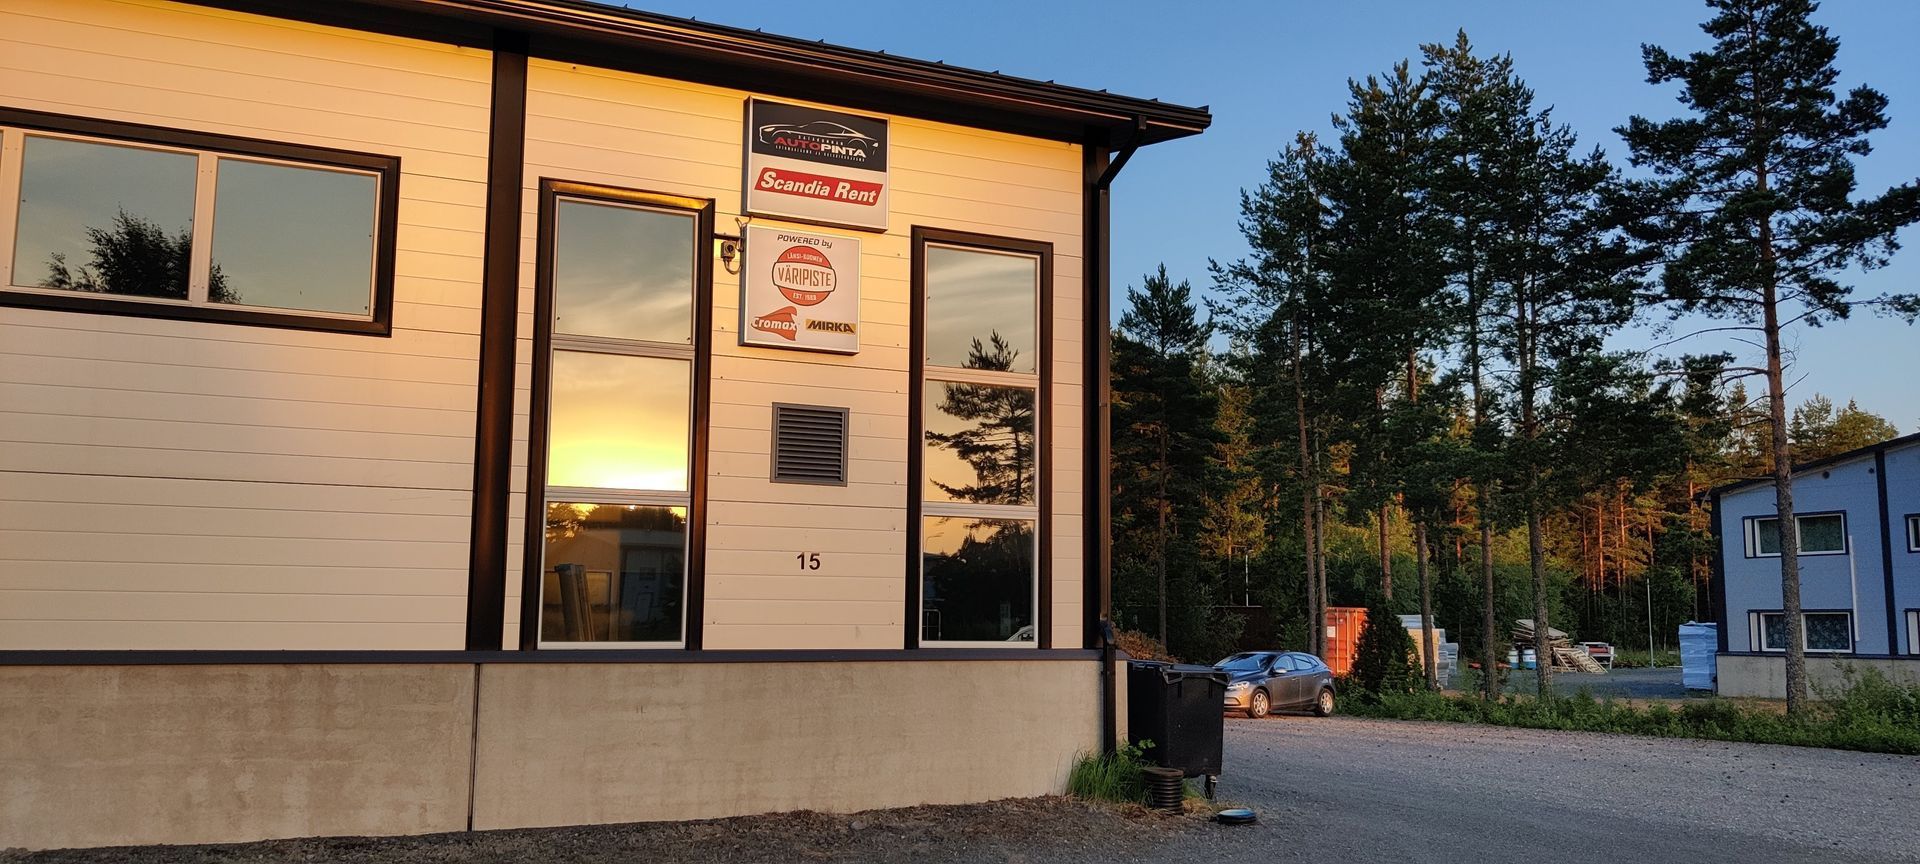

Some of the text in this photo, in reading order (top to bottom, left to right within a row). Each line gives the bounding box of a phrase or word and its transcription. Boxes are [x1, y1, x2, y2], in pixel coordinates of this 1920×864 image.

[774, 136, 867, 159] AUTOPINTA
[760, 171, 877, 203] Scandia Rent
[777, 234, 833, 249] POWERED by
[778, 264, 832, 287] VÄRIPISTE
[753, 316, 798, 331] Cromax
[807, 320, 855, 334] MIRKA
[796, 551, 821, 571] 15
